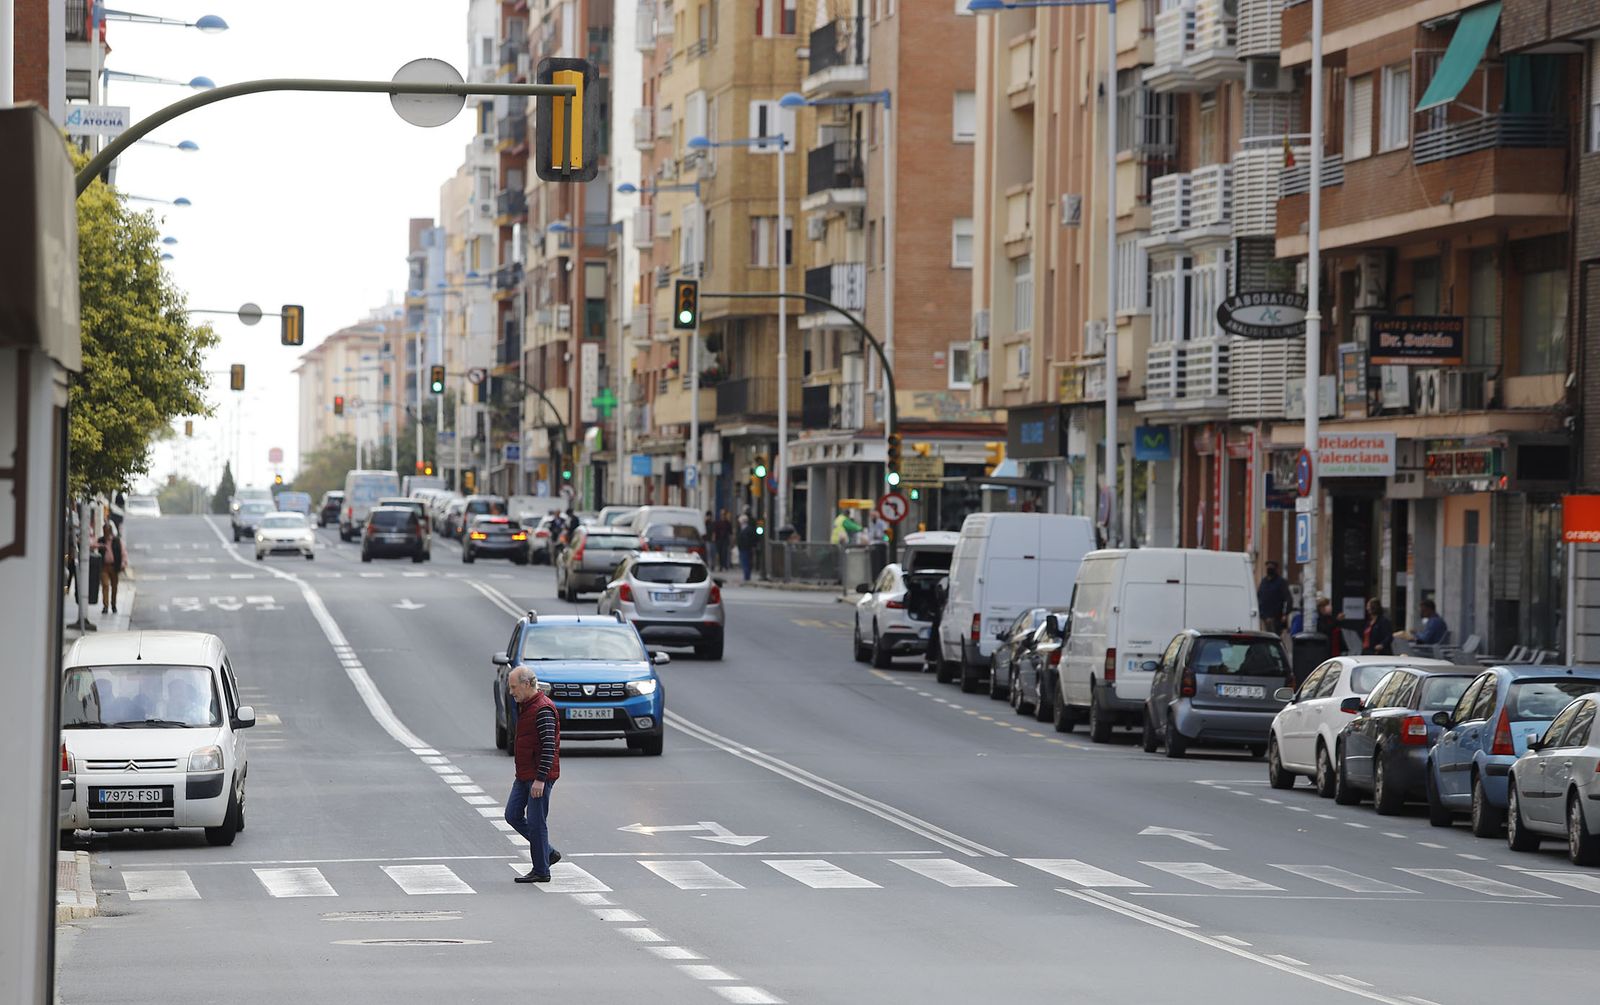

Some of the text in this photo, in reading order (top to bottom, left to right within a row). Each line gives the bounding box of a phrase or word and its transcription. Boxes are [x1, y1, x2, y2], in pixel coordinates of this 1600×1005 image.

[82, 118, 123, 126] ATOCHA
[1224, 292, 1308, 312] LABORATORI
[1379, 332, 1402, 347] Dr.
[1298, 519, 1307, 558] P
[1566, 530, 1600, 543] orang
[572, 708, 613, 718] 2415 KRT
[105, 790, 160, 801] 7975 FSD
